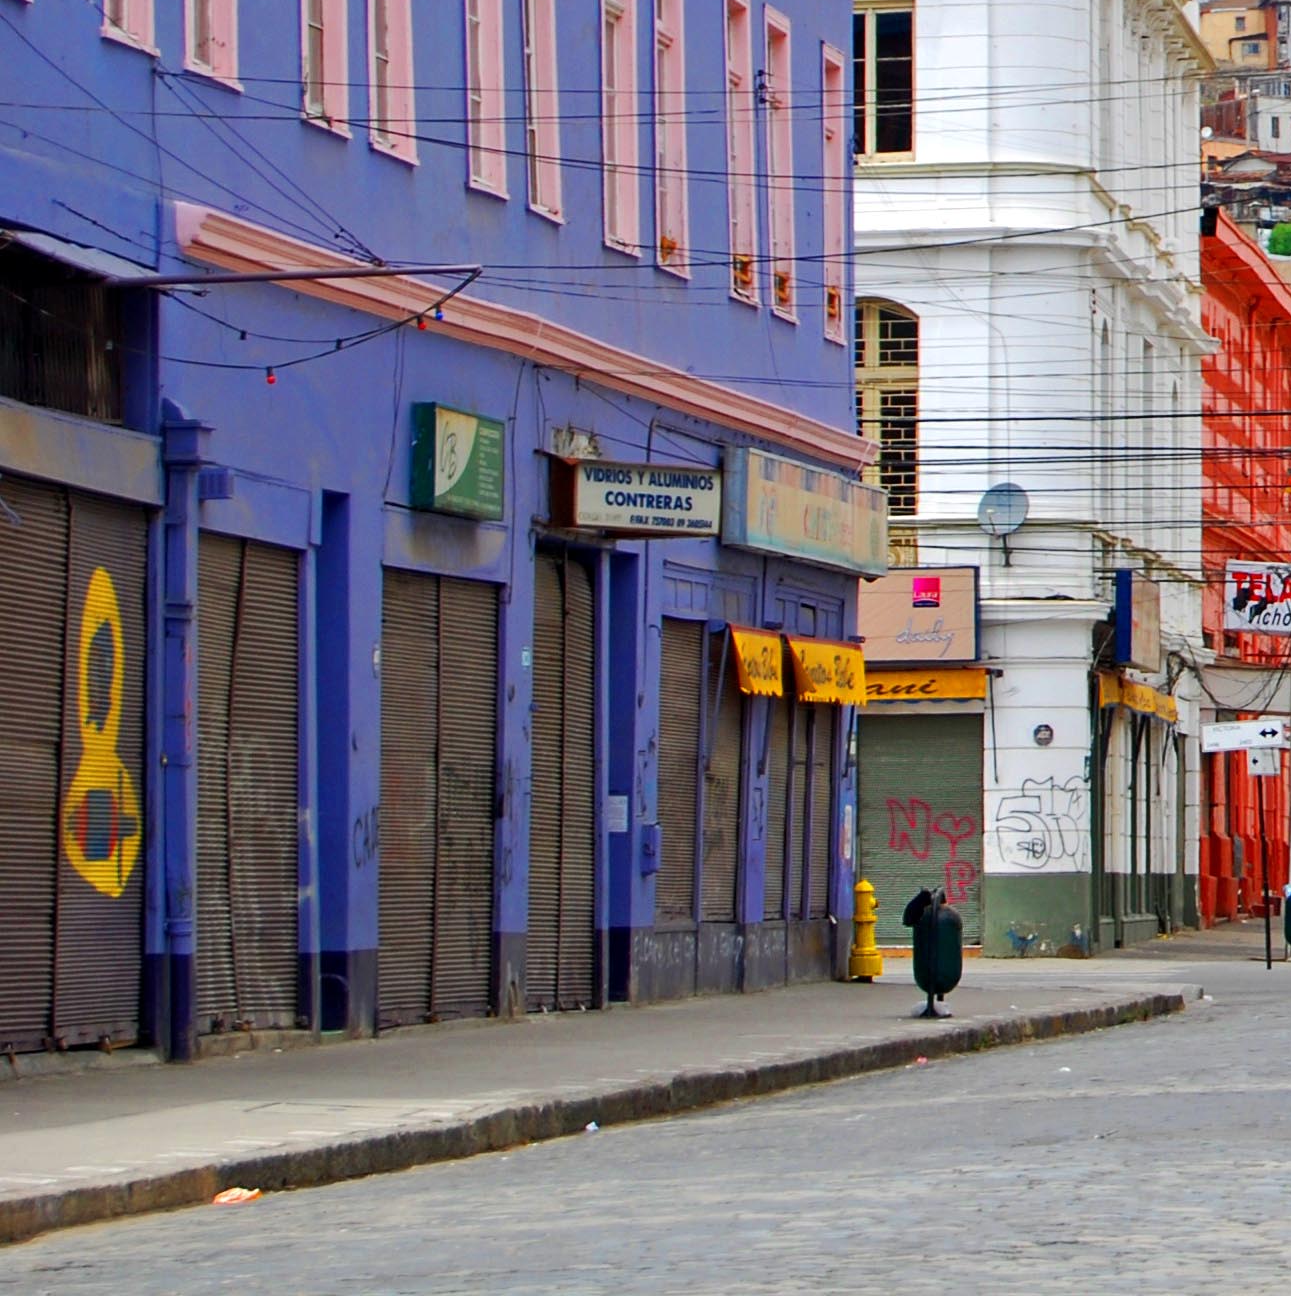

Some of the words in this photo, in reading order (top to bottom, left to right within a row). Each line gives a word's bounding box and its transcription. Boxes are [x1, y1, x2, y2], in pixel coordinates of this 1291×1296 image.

[584, 467, 632, 485] VIDRIOS
[637, 470, 645, 486] Y
[648, 471, 714, 491] ALUMINIOS
[605, 491, 693, 512] CONTRERAS
